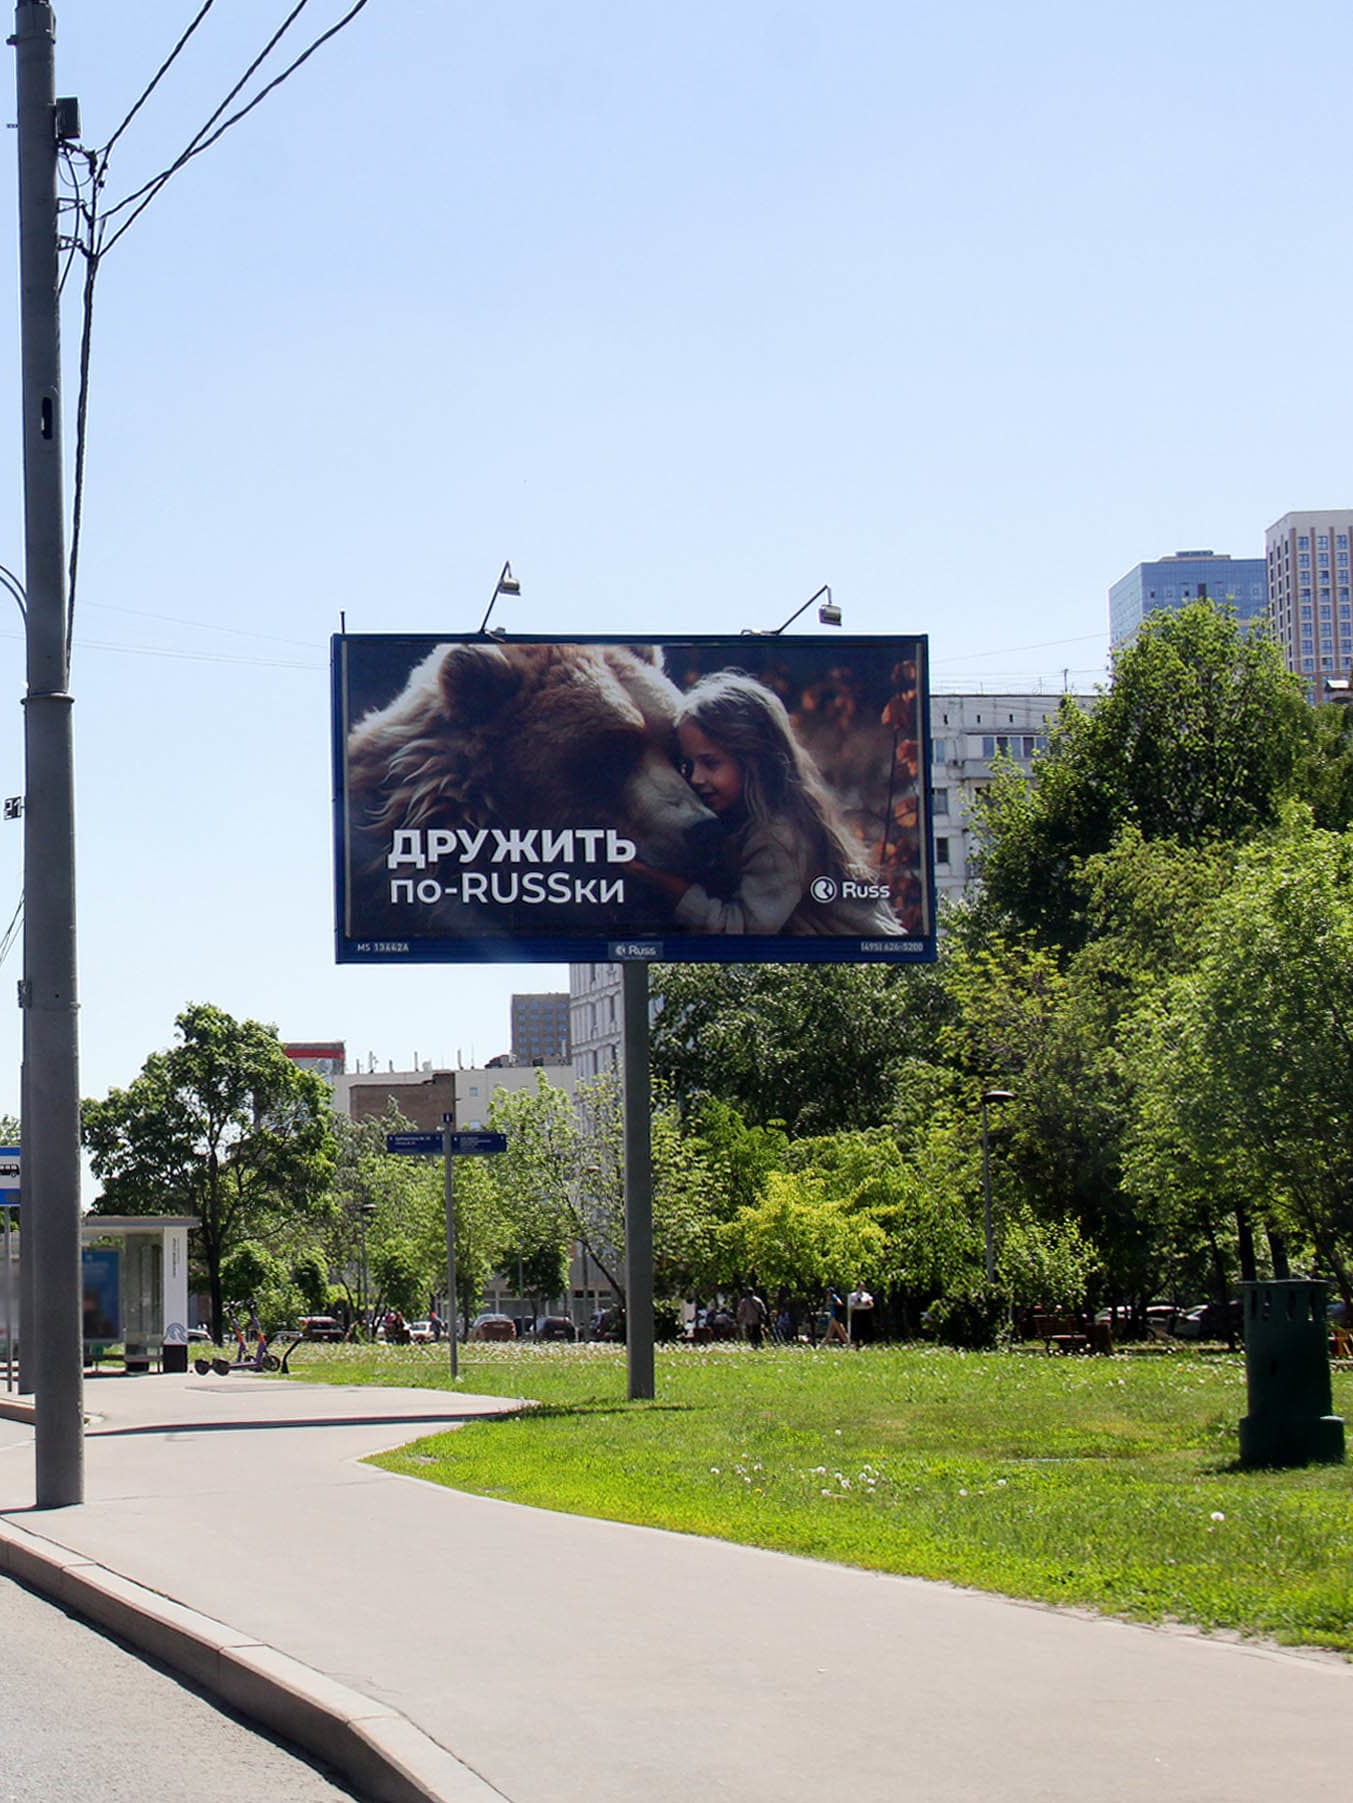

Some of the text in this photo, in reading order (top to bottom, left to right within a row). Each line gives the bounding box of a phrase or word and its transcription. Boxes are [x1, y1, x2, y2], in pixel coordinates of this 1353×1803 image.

[387, 829, 637, 869] ДРУЖИТЬ
[390, 872, 625, 904] по-RUSSки
[842, 881, 891, 898] Russ
[628, 944, 657, 956] Russ
